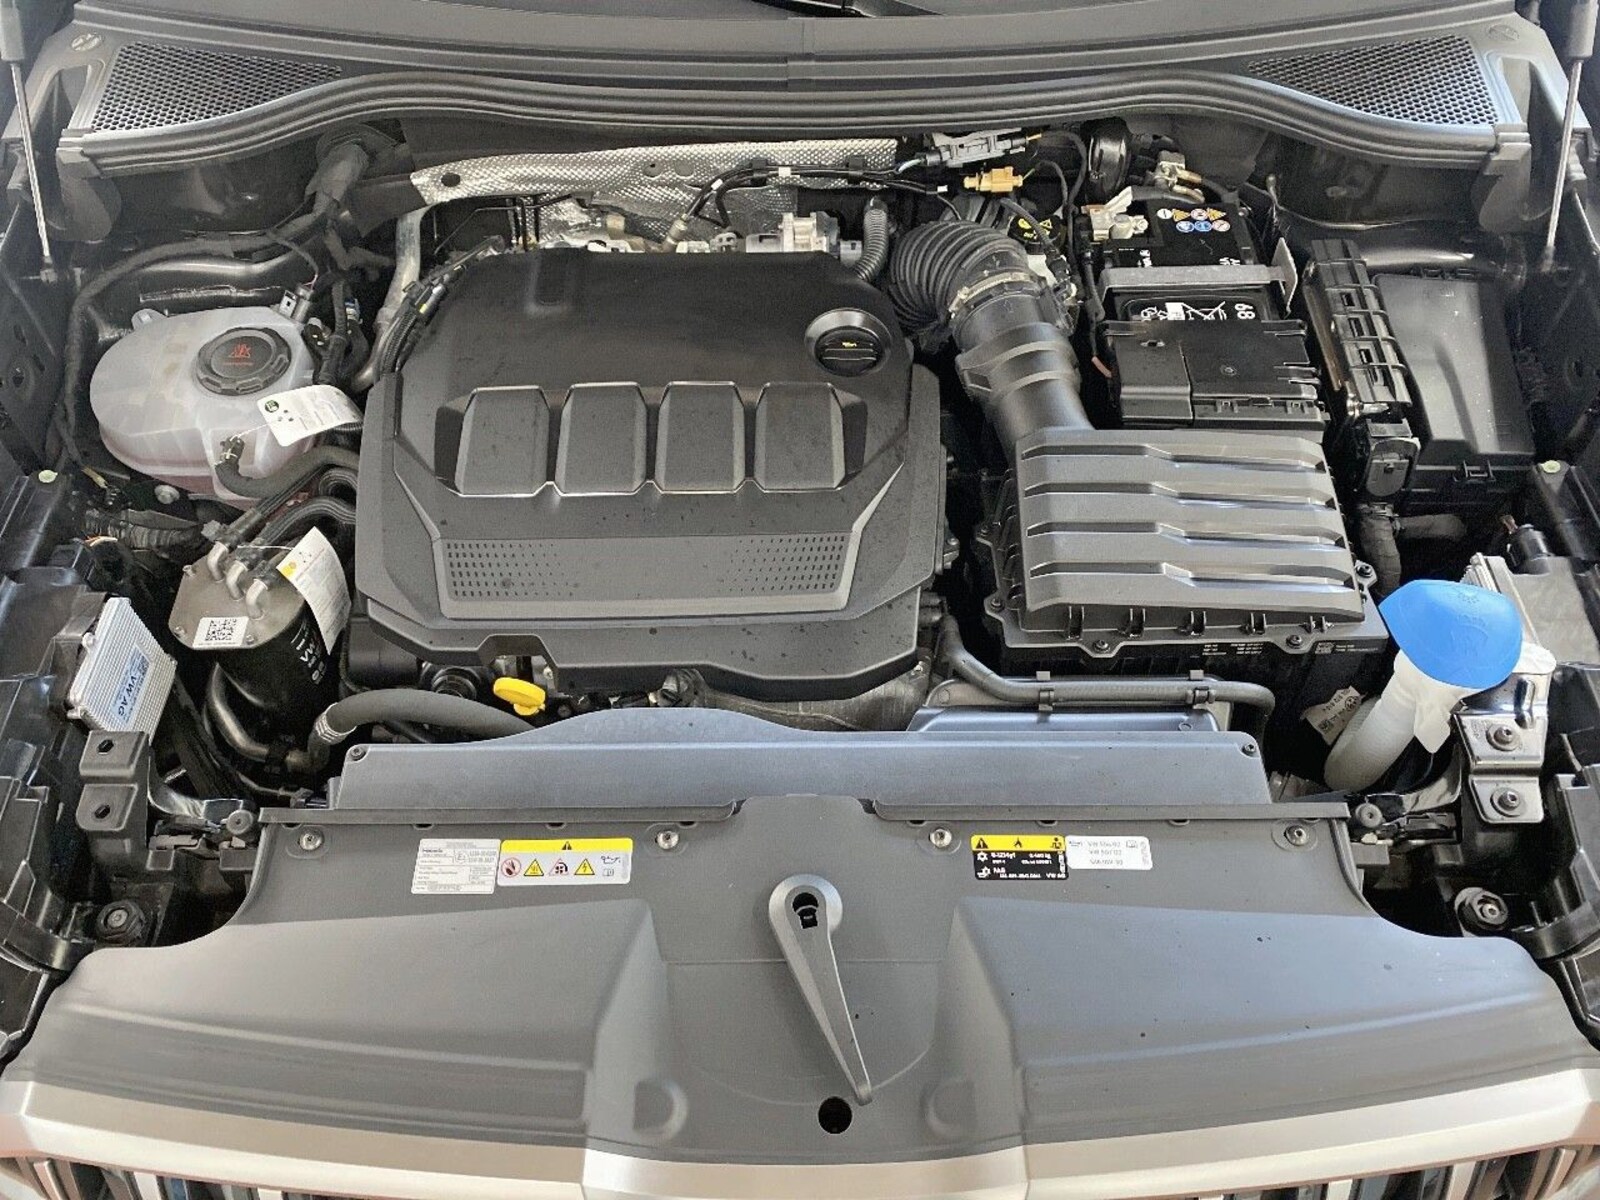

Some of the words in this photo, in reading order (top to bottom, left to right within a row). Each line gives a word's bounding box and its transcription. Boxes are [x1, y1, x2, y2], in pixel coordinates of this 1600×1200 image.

[1234, 303, 1256, 320] 68
[126, 675, 138, 698] VW
[118, 697, 129, 717] AG
